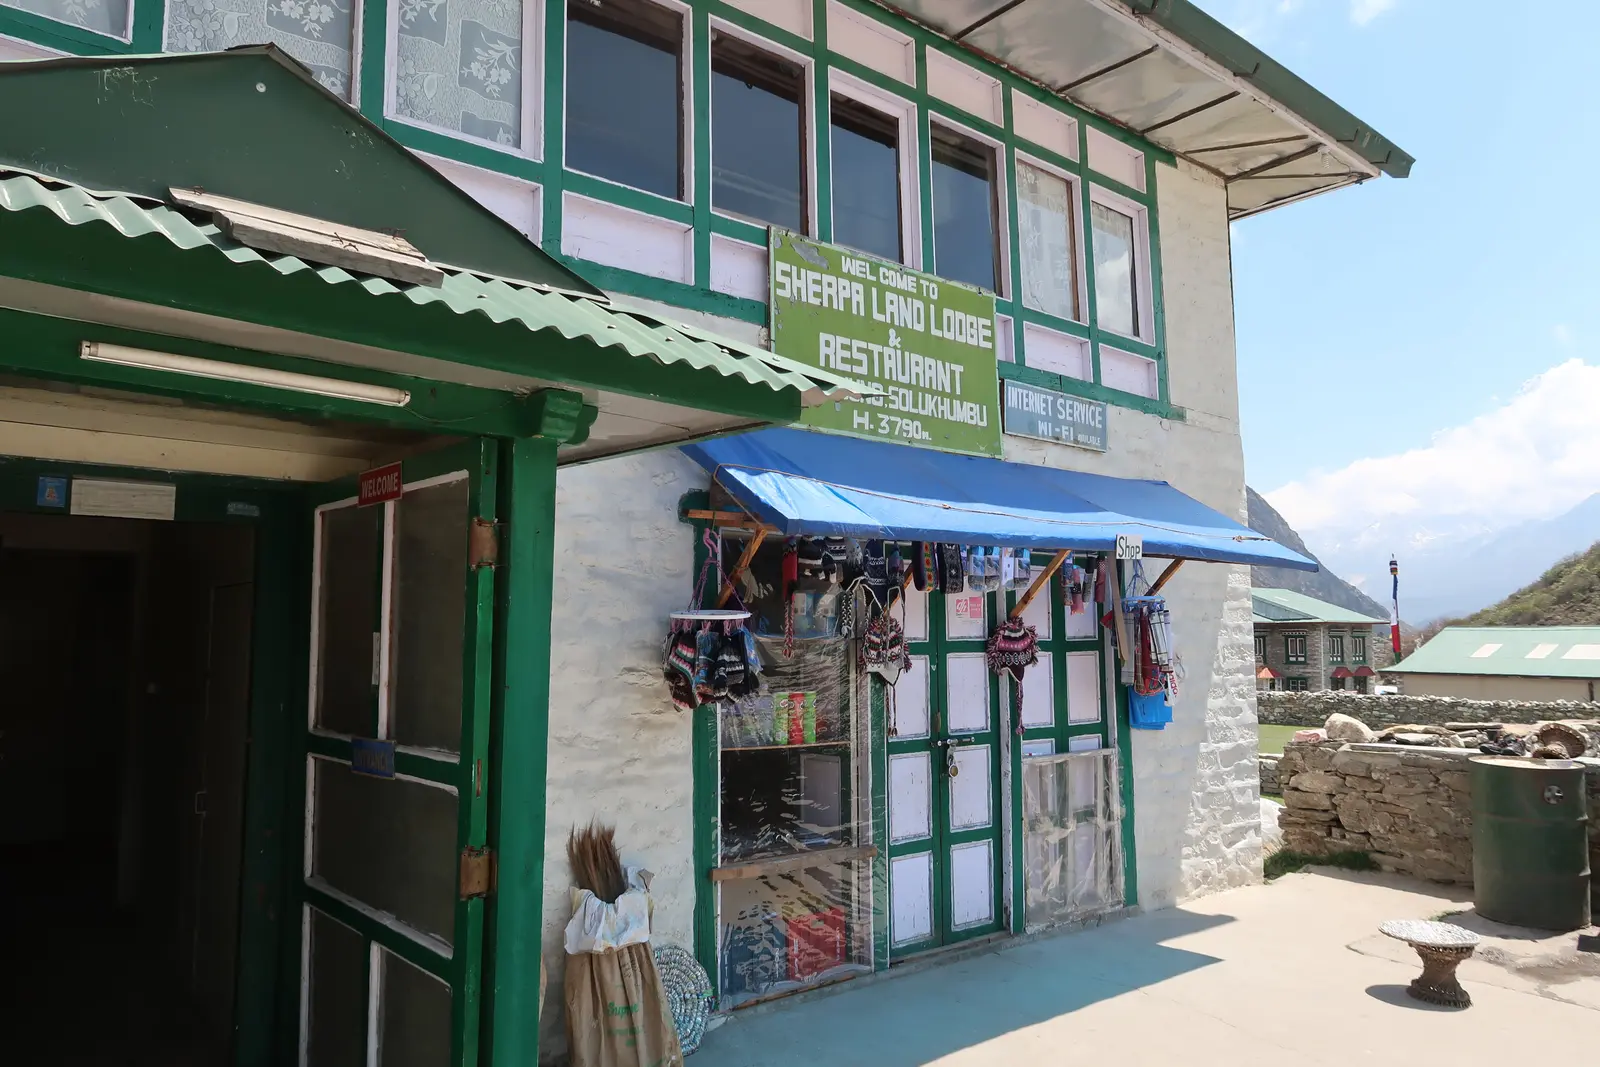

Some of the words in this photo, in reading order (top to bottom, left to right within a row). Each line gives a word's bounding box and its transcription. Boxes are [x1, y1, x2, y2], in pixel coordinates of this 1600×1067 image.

[879, 266, 917, 294] COME
[920, 278, 939, 300] TO
[775, 260, 865, 317] SHERPA
[871, 286, 925, 332] LAND
[930, 303, 993, 349] LODGE
[888, 328, 902, 349] &
[819, 331, 964, 395] RESTAURANT
[887, 385, 988, 427] SOLUKHUMBU
[1007, 385, 1054, 417] INTERNET
[1056, 398, 1103, 429] SERVICE
[361, 471, 399, 499] WELCOME
[1117, 535, 1141, 559] Shop
